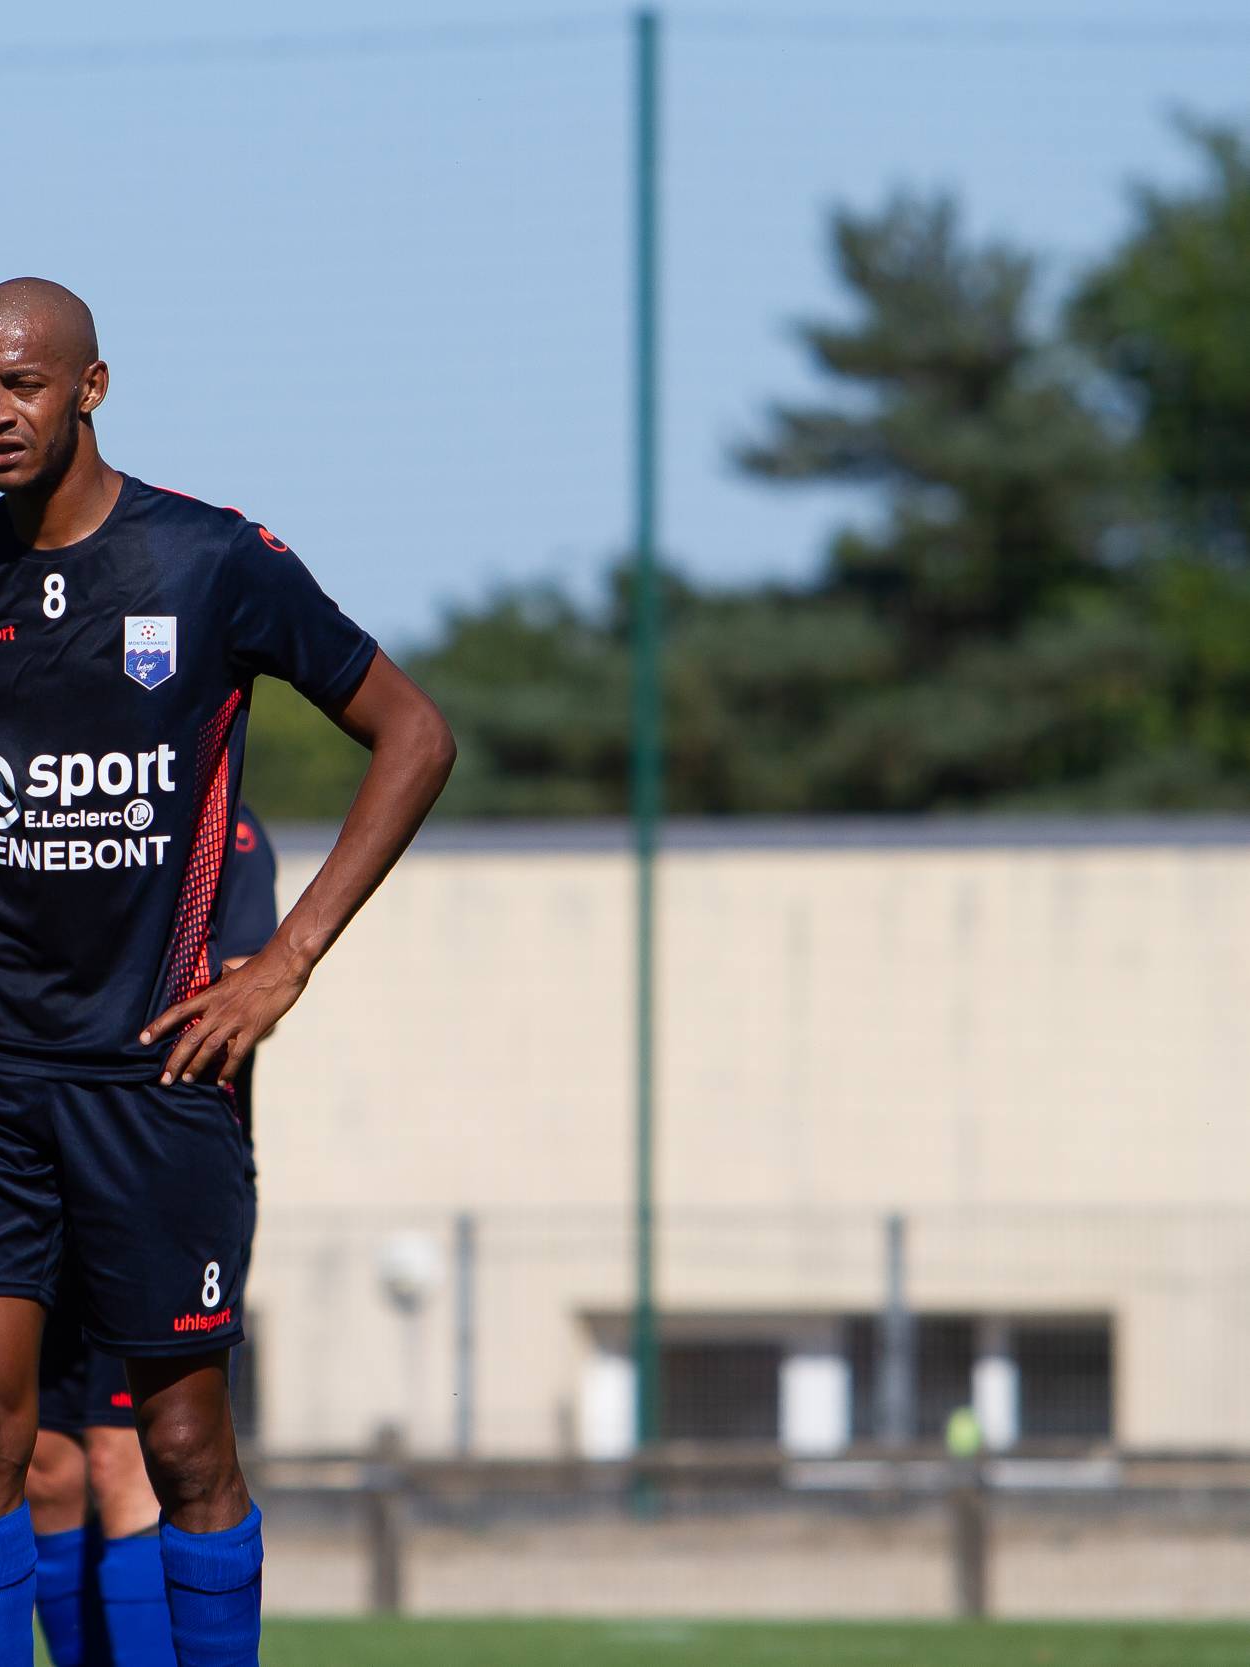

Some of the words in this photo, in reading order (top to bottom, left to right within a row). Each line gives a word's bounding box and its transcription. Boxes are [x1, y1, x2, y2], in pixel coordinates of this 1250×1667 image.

[43, 573, 66, 619] 8
[25, 744, 176, 807] sport
[24, 809, 122, 828] E.Leclerc
[202, 1261, 221, 1308] 8
[173, 1307, 231, 1333] uhlsport
